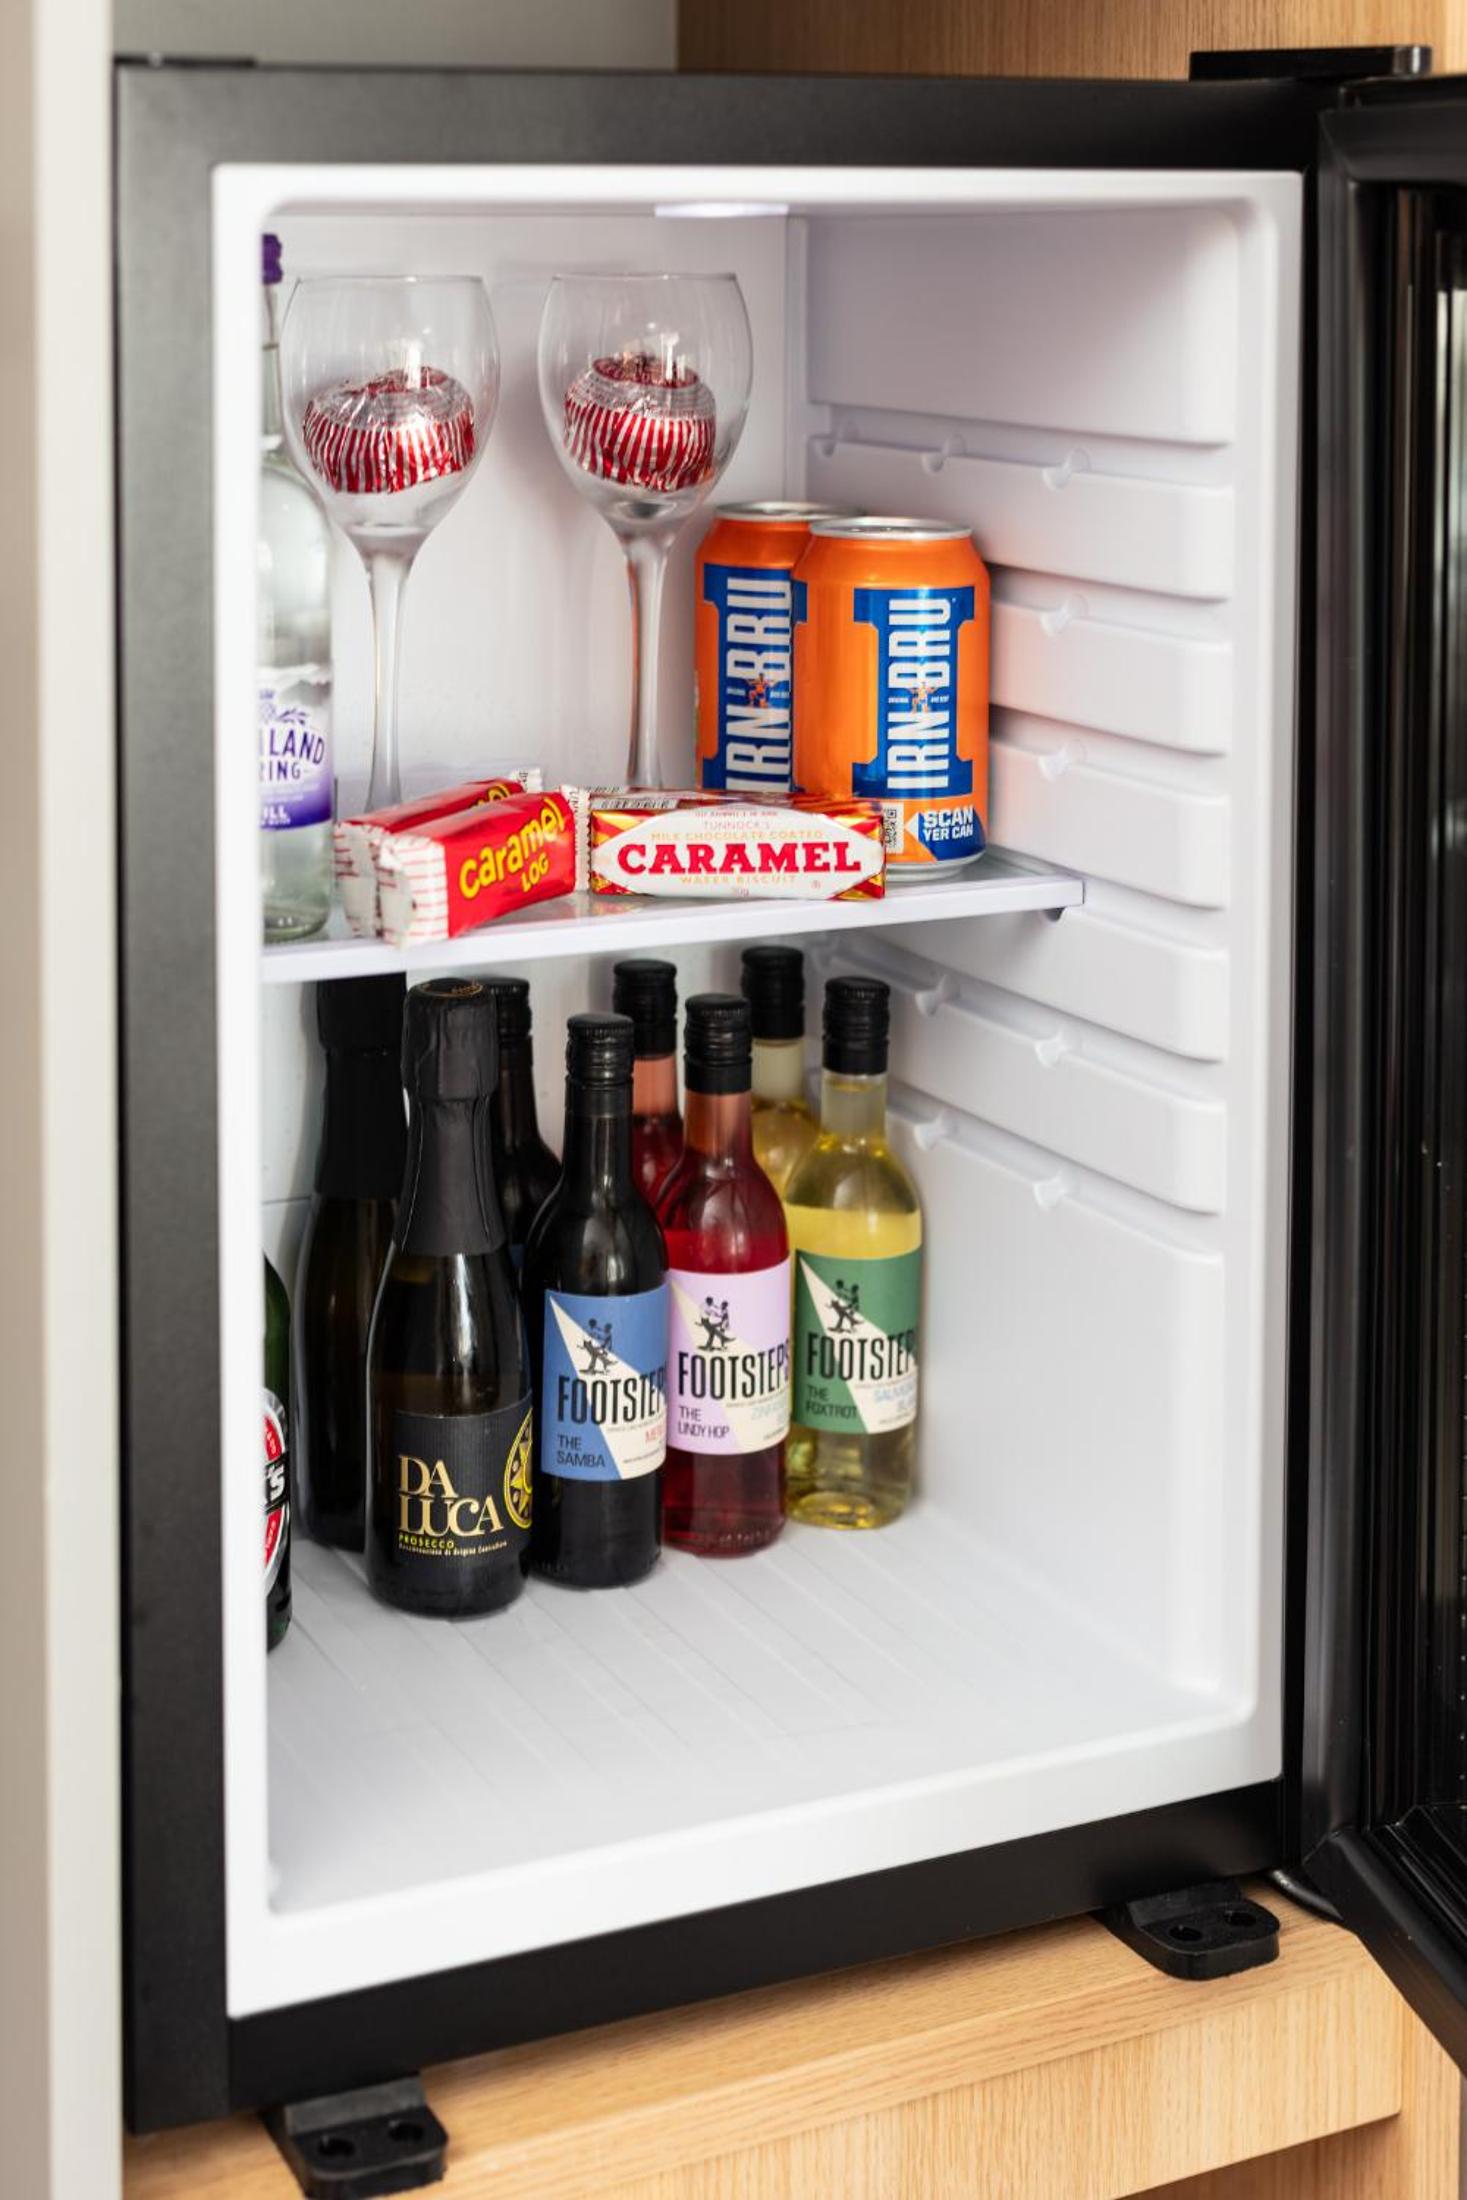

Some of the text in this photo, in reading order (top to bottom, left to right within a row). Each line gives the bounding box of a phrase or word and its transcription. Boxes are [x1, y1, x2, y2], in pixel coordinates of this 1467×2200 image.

[260, 727, 325, 766] LAND
[924, 805, 974, 828] SCAN
[651, 830, 823, 841] MILK CHOCOLATE COATED
[923, 823, 974, 842] YER CAN
[618, 841, 862, 875] CARAMEL
[521, 852, 549, 893] LOG
[680, 875, 796, 886] WAFER BISCUIT
[807, 1384, 829, 1401] THE
[679, 1405, 702, 1421] THE
[805, 1400, 858, 1419] FOXTROT
[677, 1421, 707, 1438] LINDY
[708, 1425, 730, 1439] HOP
[557, 1434, 582, 1451] THE
[556, 1451, 606, 1468] SAMBA
[399, 1455, 459, 1498] DA
[399, 1495, 504, 1537] LUCA
[399, 1533, 456, 1549] PROSECCO
